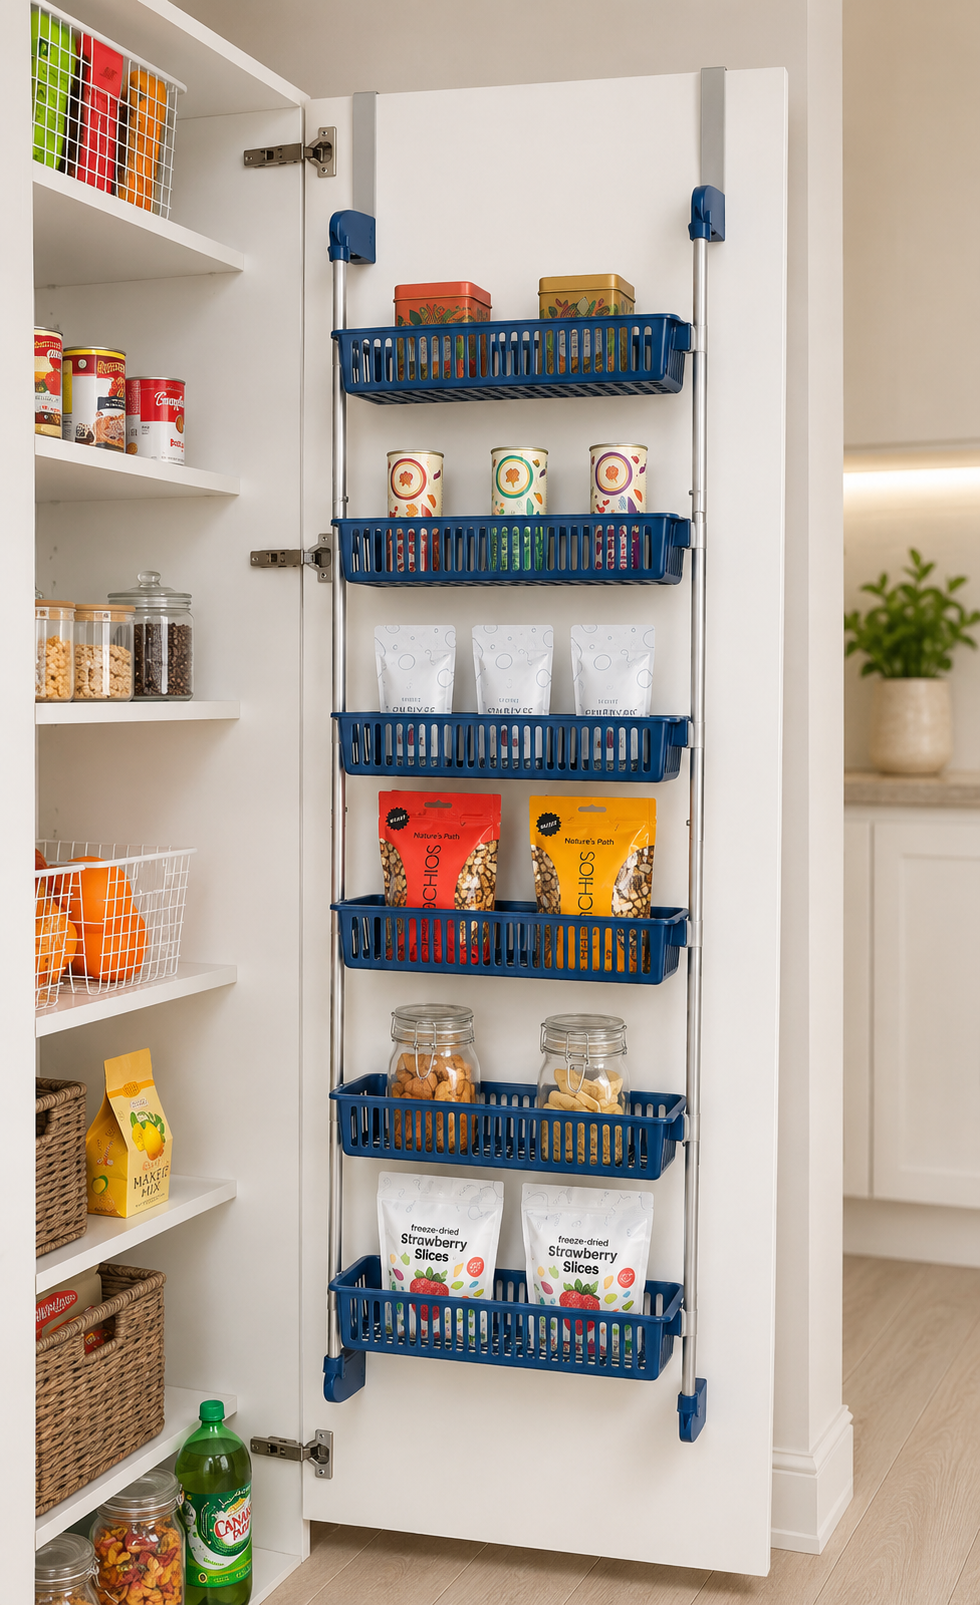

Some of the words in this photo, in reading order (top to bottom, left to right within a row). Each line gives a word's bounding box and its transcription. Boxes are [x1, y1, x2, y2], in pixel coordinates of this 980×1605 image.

[413, 832, 442, 840] Nature's
[444, 832, 460, 840] Path
[564, 837, 595, 845] Nature's
[597, 838, 615, 846] Path
[410, 1223, 460, 1236] freeze-dried
[400, 1233, 468, 1253] Strawberry
[557, 1235, 610, 1248] freeze-dried
[414, 1248, 449, 1263] Slices
[547, 1245, 618, 1264] Strawberry
[562, 1260, 600, 1275] Slices
